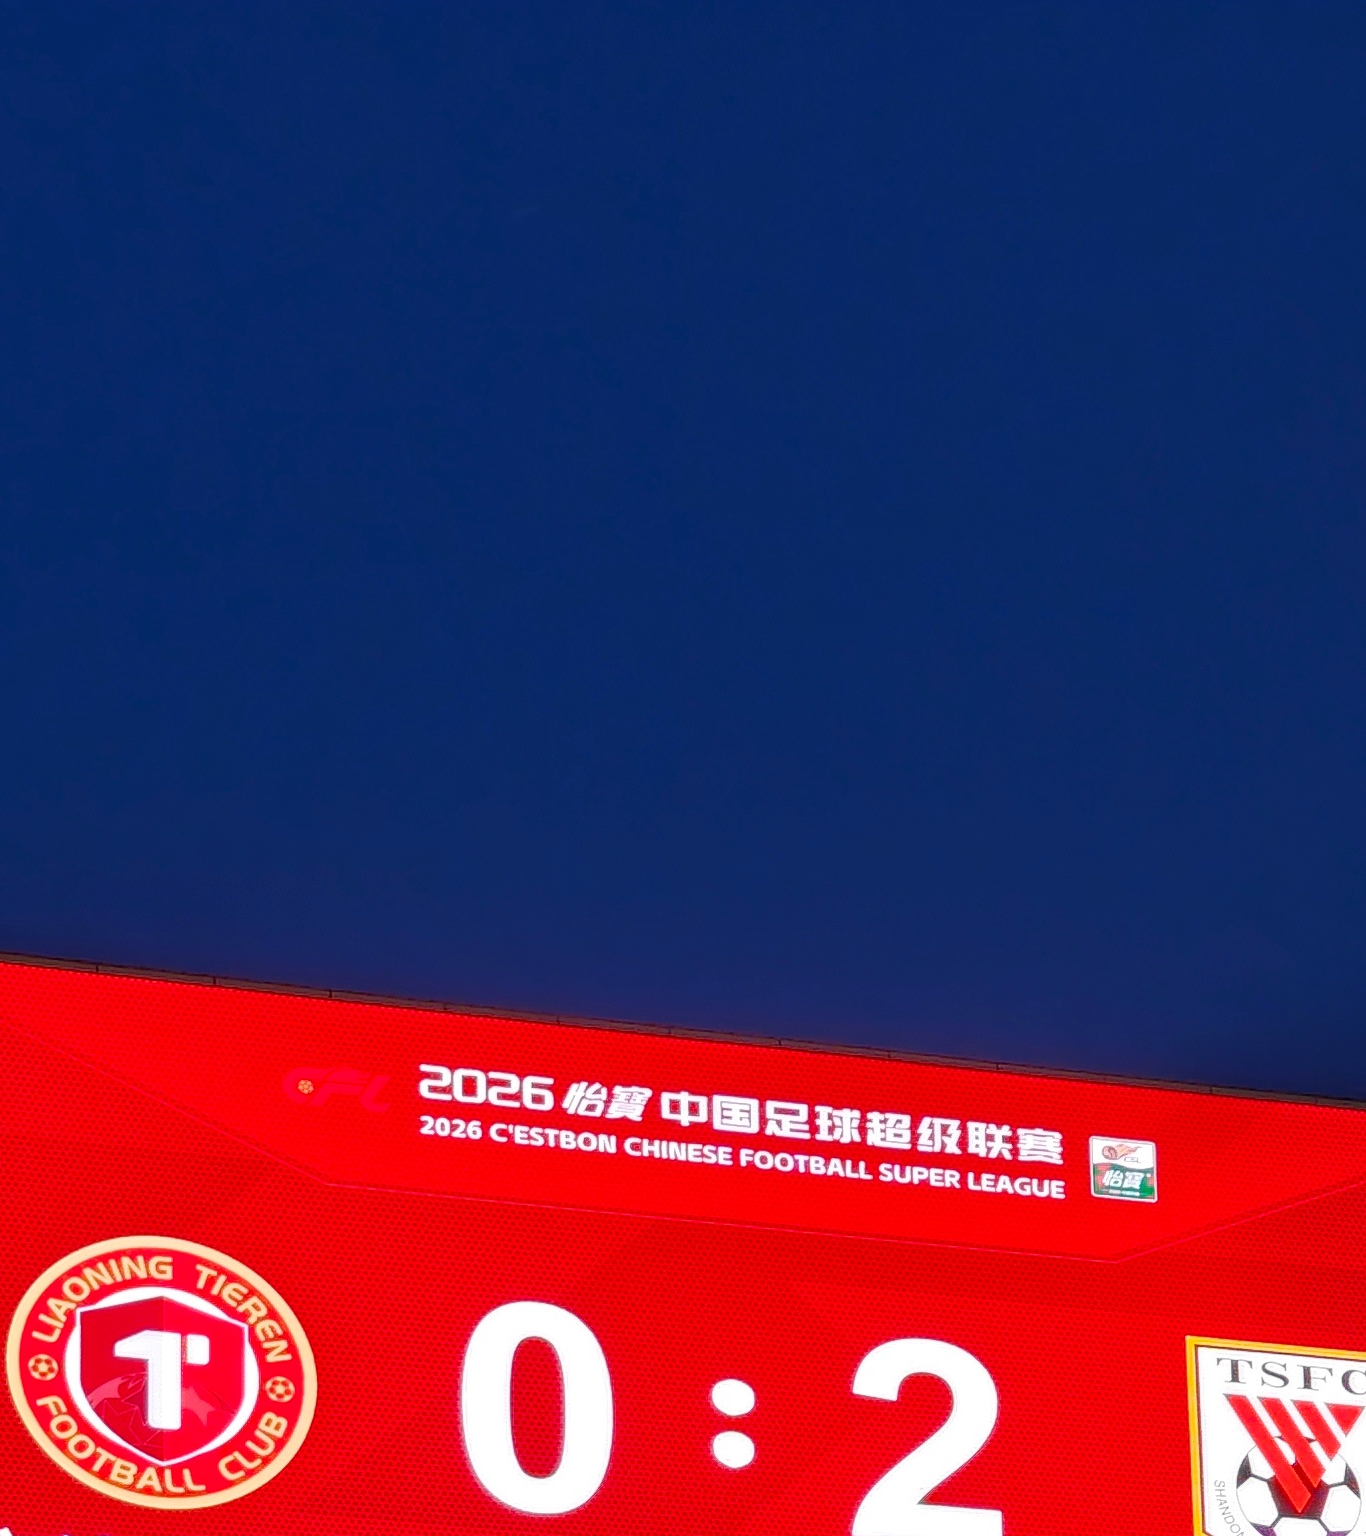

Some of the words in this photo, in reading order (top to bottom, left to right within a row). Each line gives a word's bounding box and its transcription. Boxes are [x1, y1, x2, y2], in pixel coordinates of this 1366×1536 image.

[419, 1064, 554, 1111] 2026
[660, 1091, 1064, 1165] 中国足球超级联赛
[419, 1115, 483, 1139] 2026
[489, 1123, 618, 1154] C'ESTBON
[623, 1137, 733, 1166] CHINESE
[740, 1148, 873, 1180] FOOTBALL
[879, 1163, 961, 1189] SUPER
[967, 1172, 1066, 1200] LEAGUE
[31, 1254, 174, 1343] LIAONING
[195, 1264, 293, 1363] TIEREN
[36, 1395, 207, 1494] FOOTBALL
[218, 1411, 288, 1482] CLUB
[460, 1301, 614, 1516] 0
